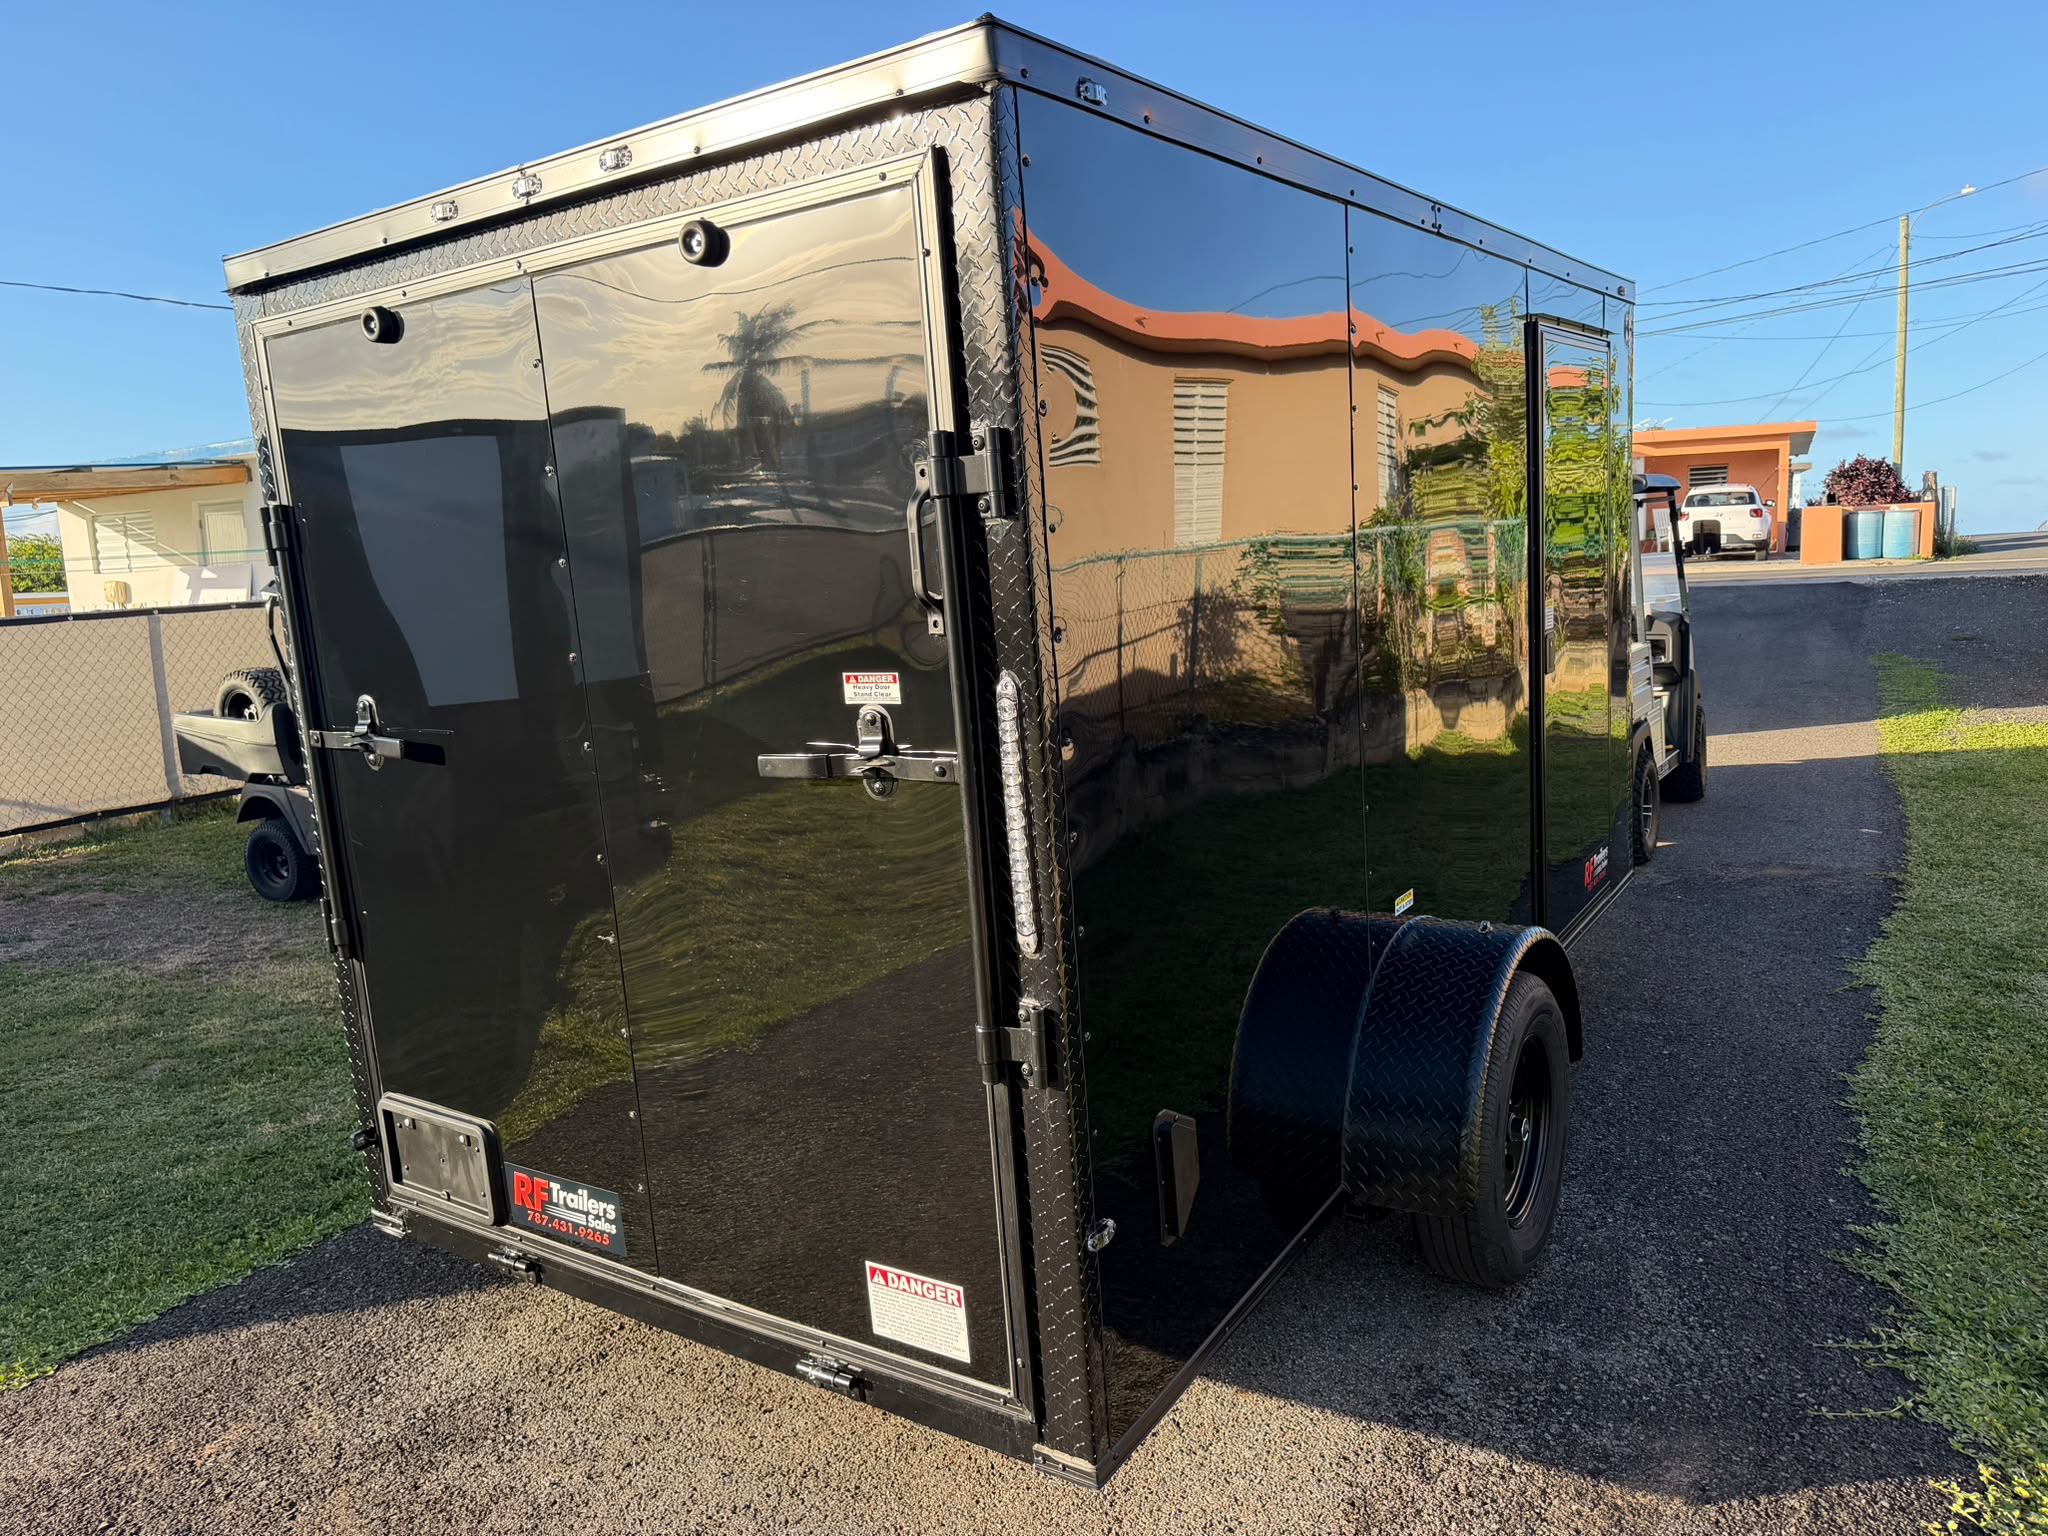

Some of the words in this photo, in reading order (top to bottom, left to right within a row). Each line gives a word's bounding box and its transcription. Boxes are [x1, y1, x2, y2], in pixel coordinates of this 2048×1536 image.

[858, 675, 894, 683] DANGER
[513, 1171, 550, 1212] RF
[549, 1182, 616, 1220] Trailers
[527, 1210, 610, 1247] 787.431.9265
[588, 1215, 617, 1235] Sales
[886, 1271, 961, 1307] DANGER
